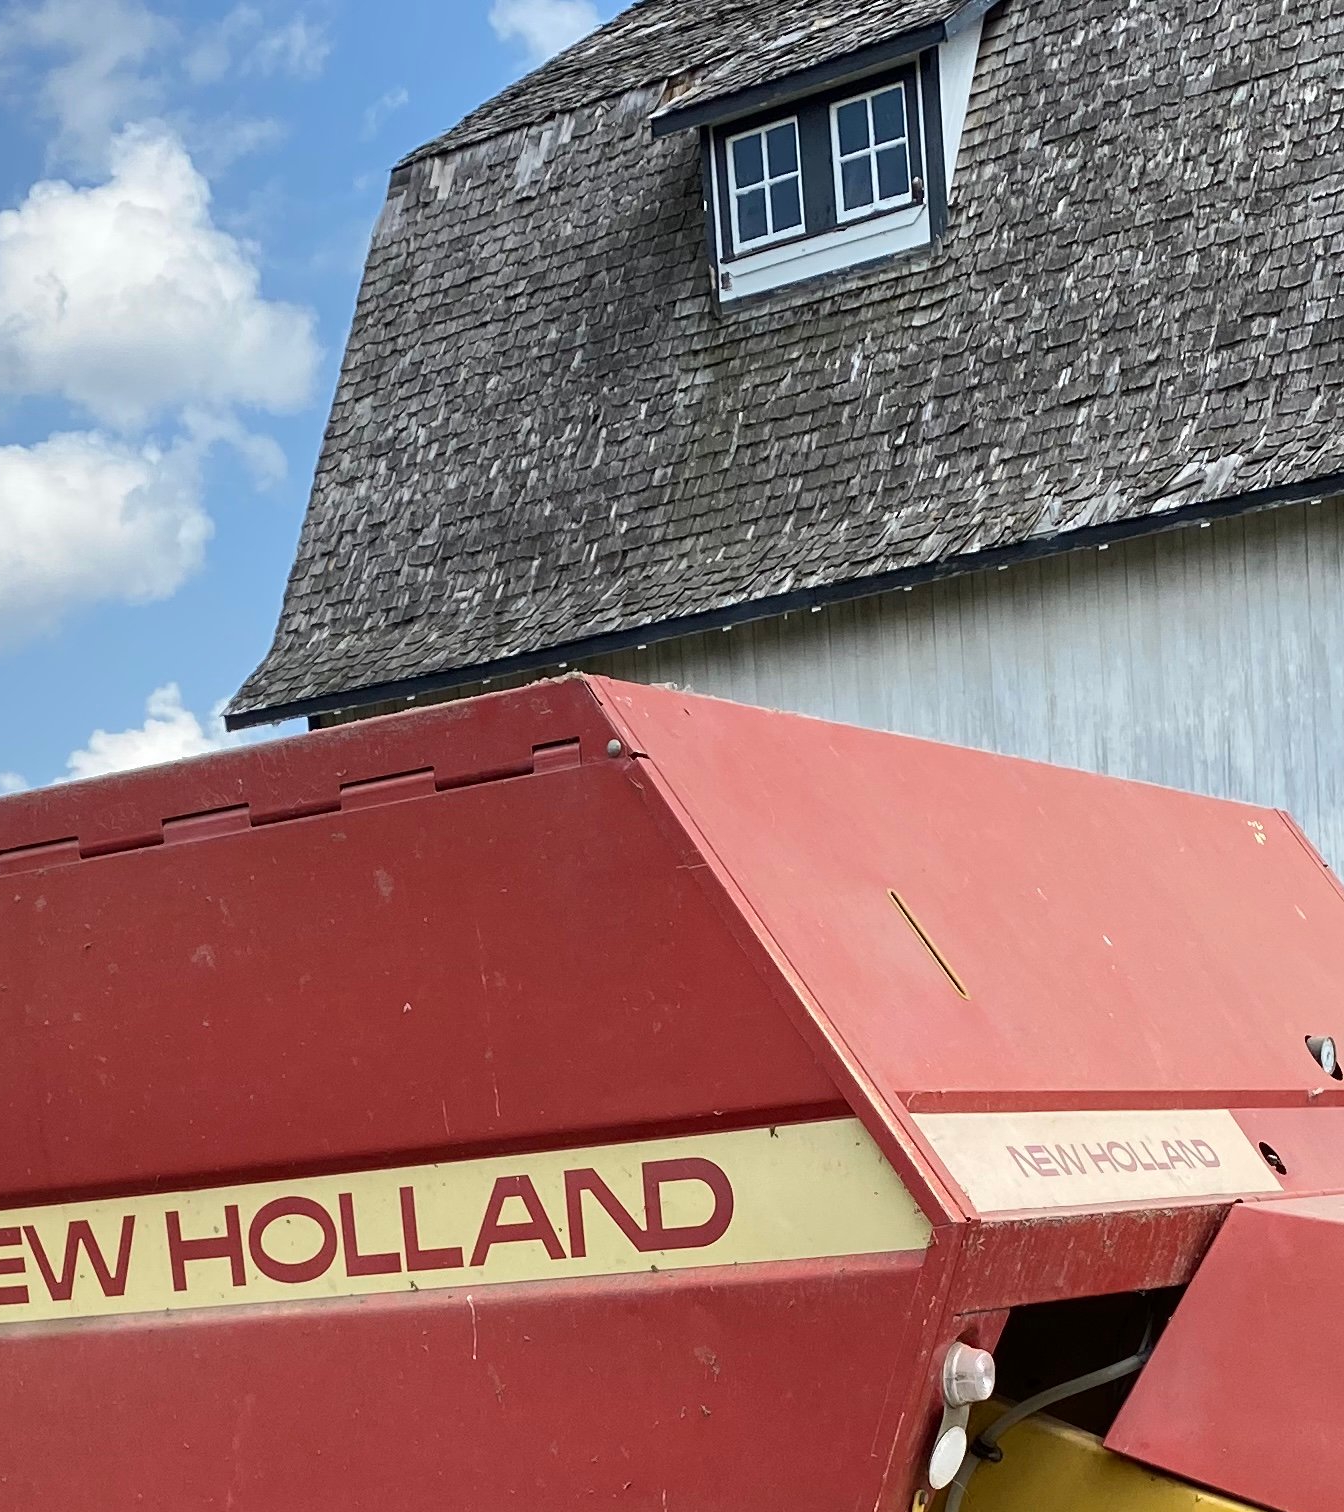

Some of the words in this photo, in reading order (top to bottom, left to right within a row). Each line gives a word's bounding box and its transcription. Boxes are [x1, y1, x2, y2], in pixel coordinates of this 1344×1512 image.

[1006, 1143, 1087, 1178] NEW
[1082, 1139, 1221, 1174] HOLLAND
[165, 1156, 735, 1292] HOLLAND
